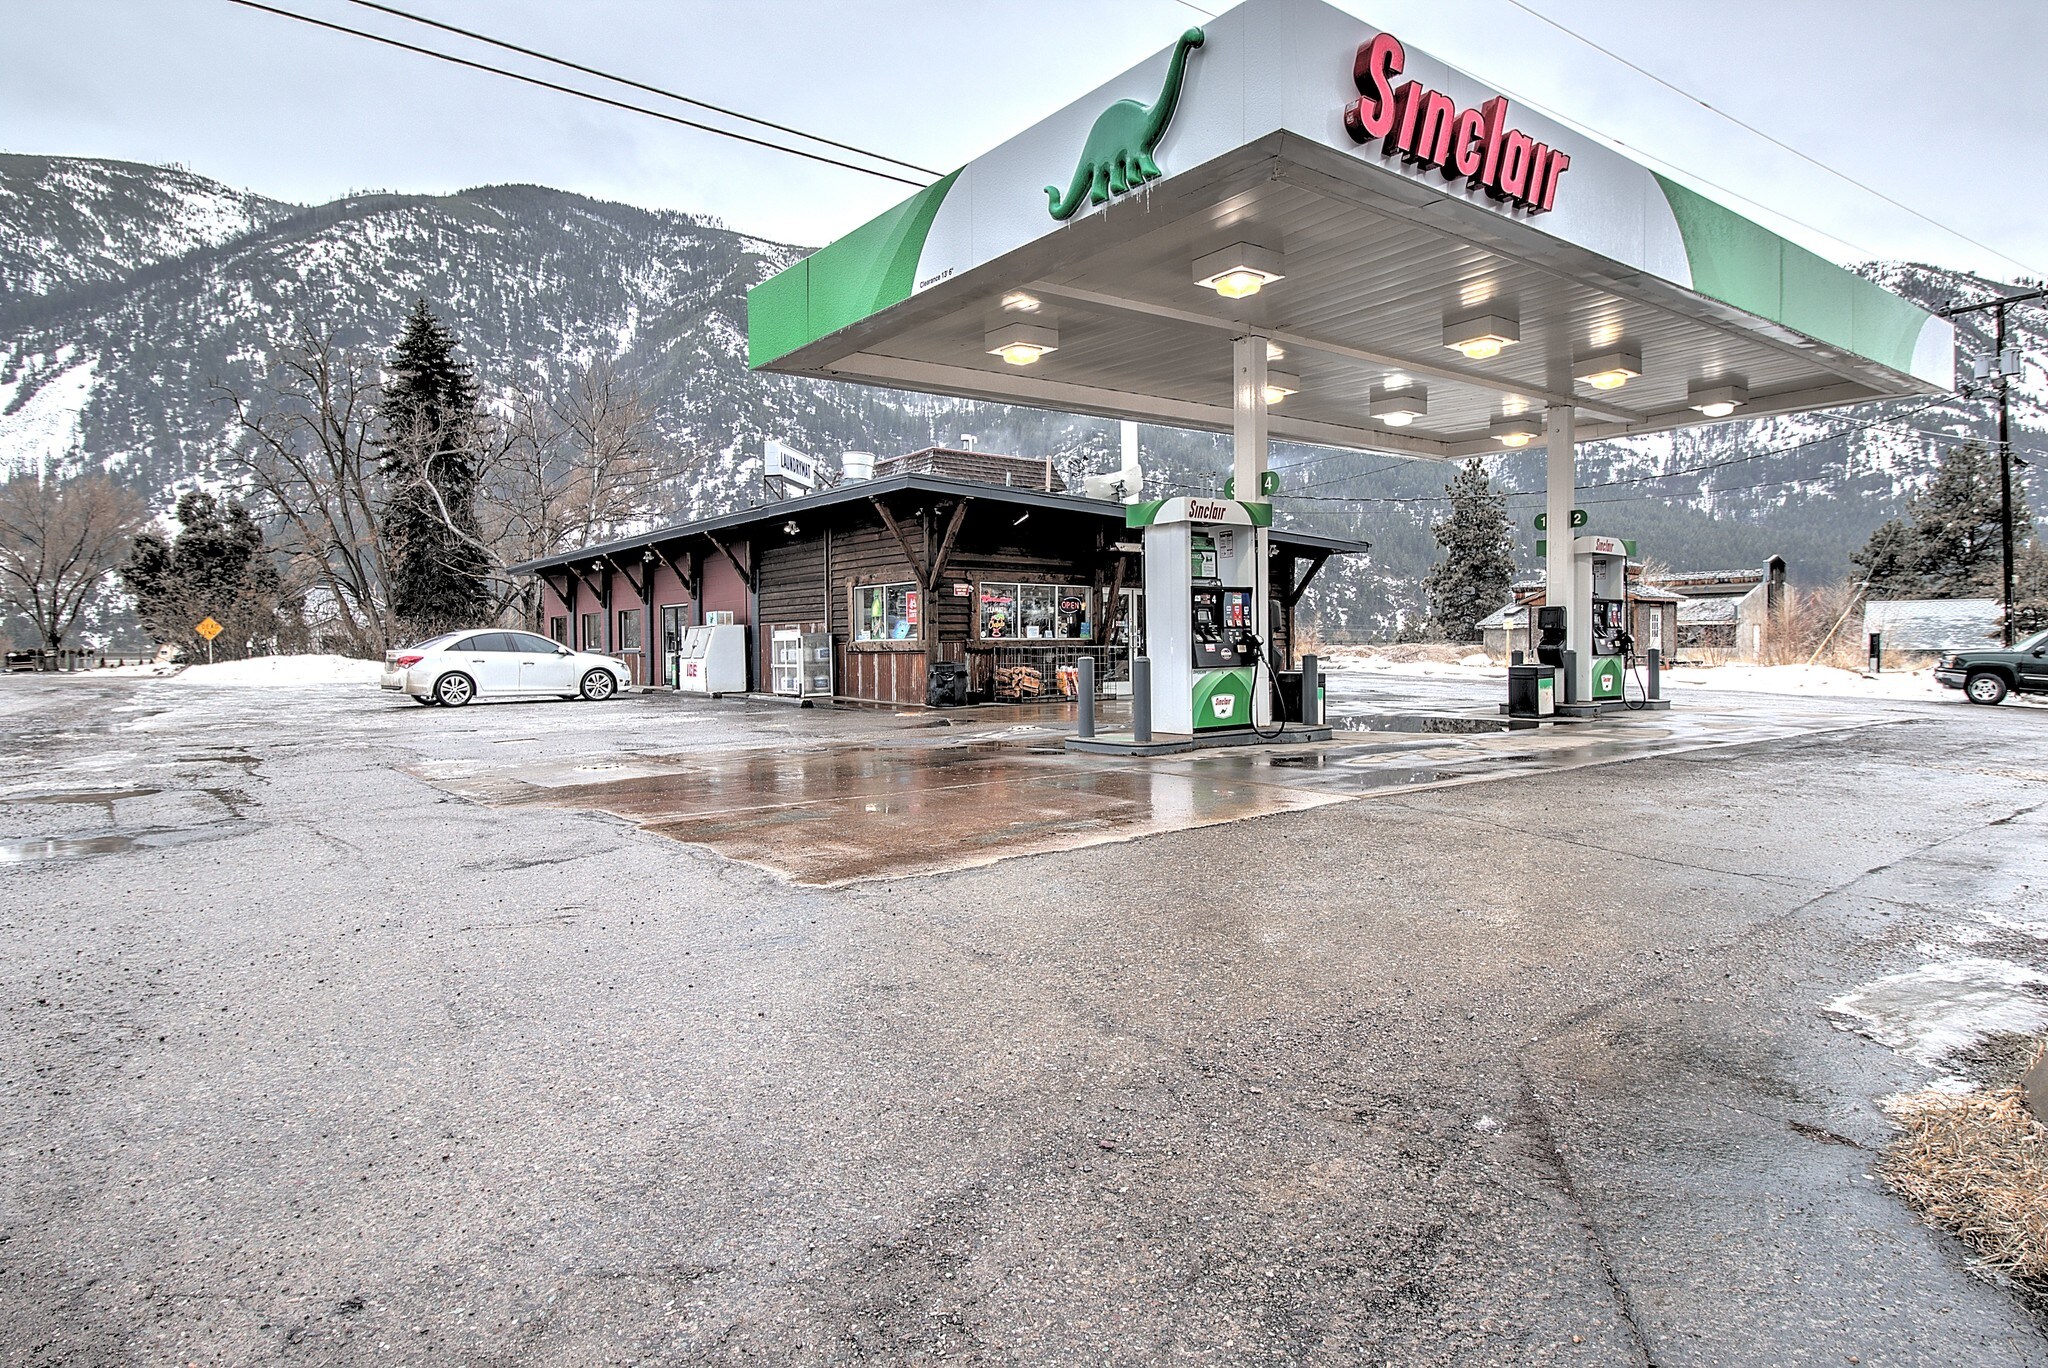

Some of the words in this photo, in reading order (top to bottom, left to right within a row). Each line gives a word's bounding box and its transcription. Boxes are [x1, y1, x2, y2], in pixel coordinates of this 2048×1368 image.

[1345, 32, 1571, 215] Sinclair
[919, 275, 941, 288] Clearance
[1264, 476, 1273, 490] 4
[1189, 500, 1226, 520] Sinclair
[1540, 516, 1547, 527] 1
[1573, 513, 1582, 524] 2
[1596, 538, 1614, 552] Sinclair
[1061, 601, 1080, 610] OPEN
[1211, 595, 1217, 604] 4
[686, 663, 697, 677] ICE
